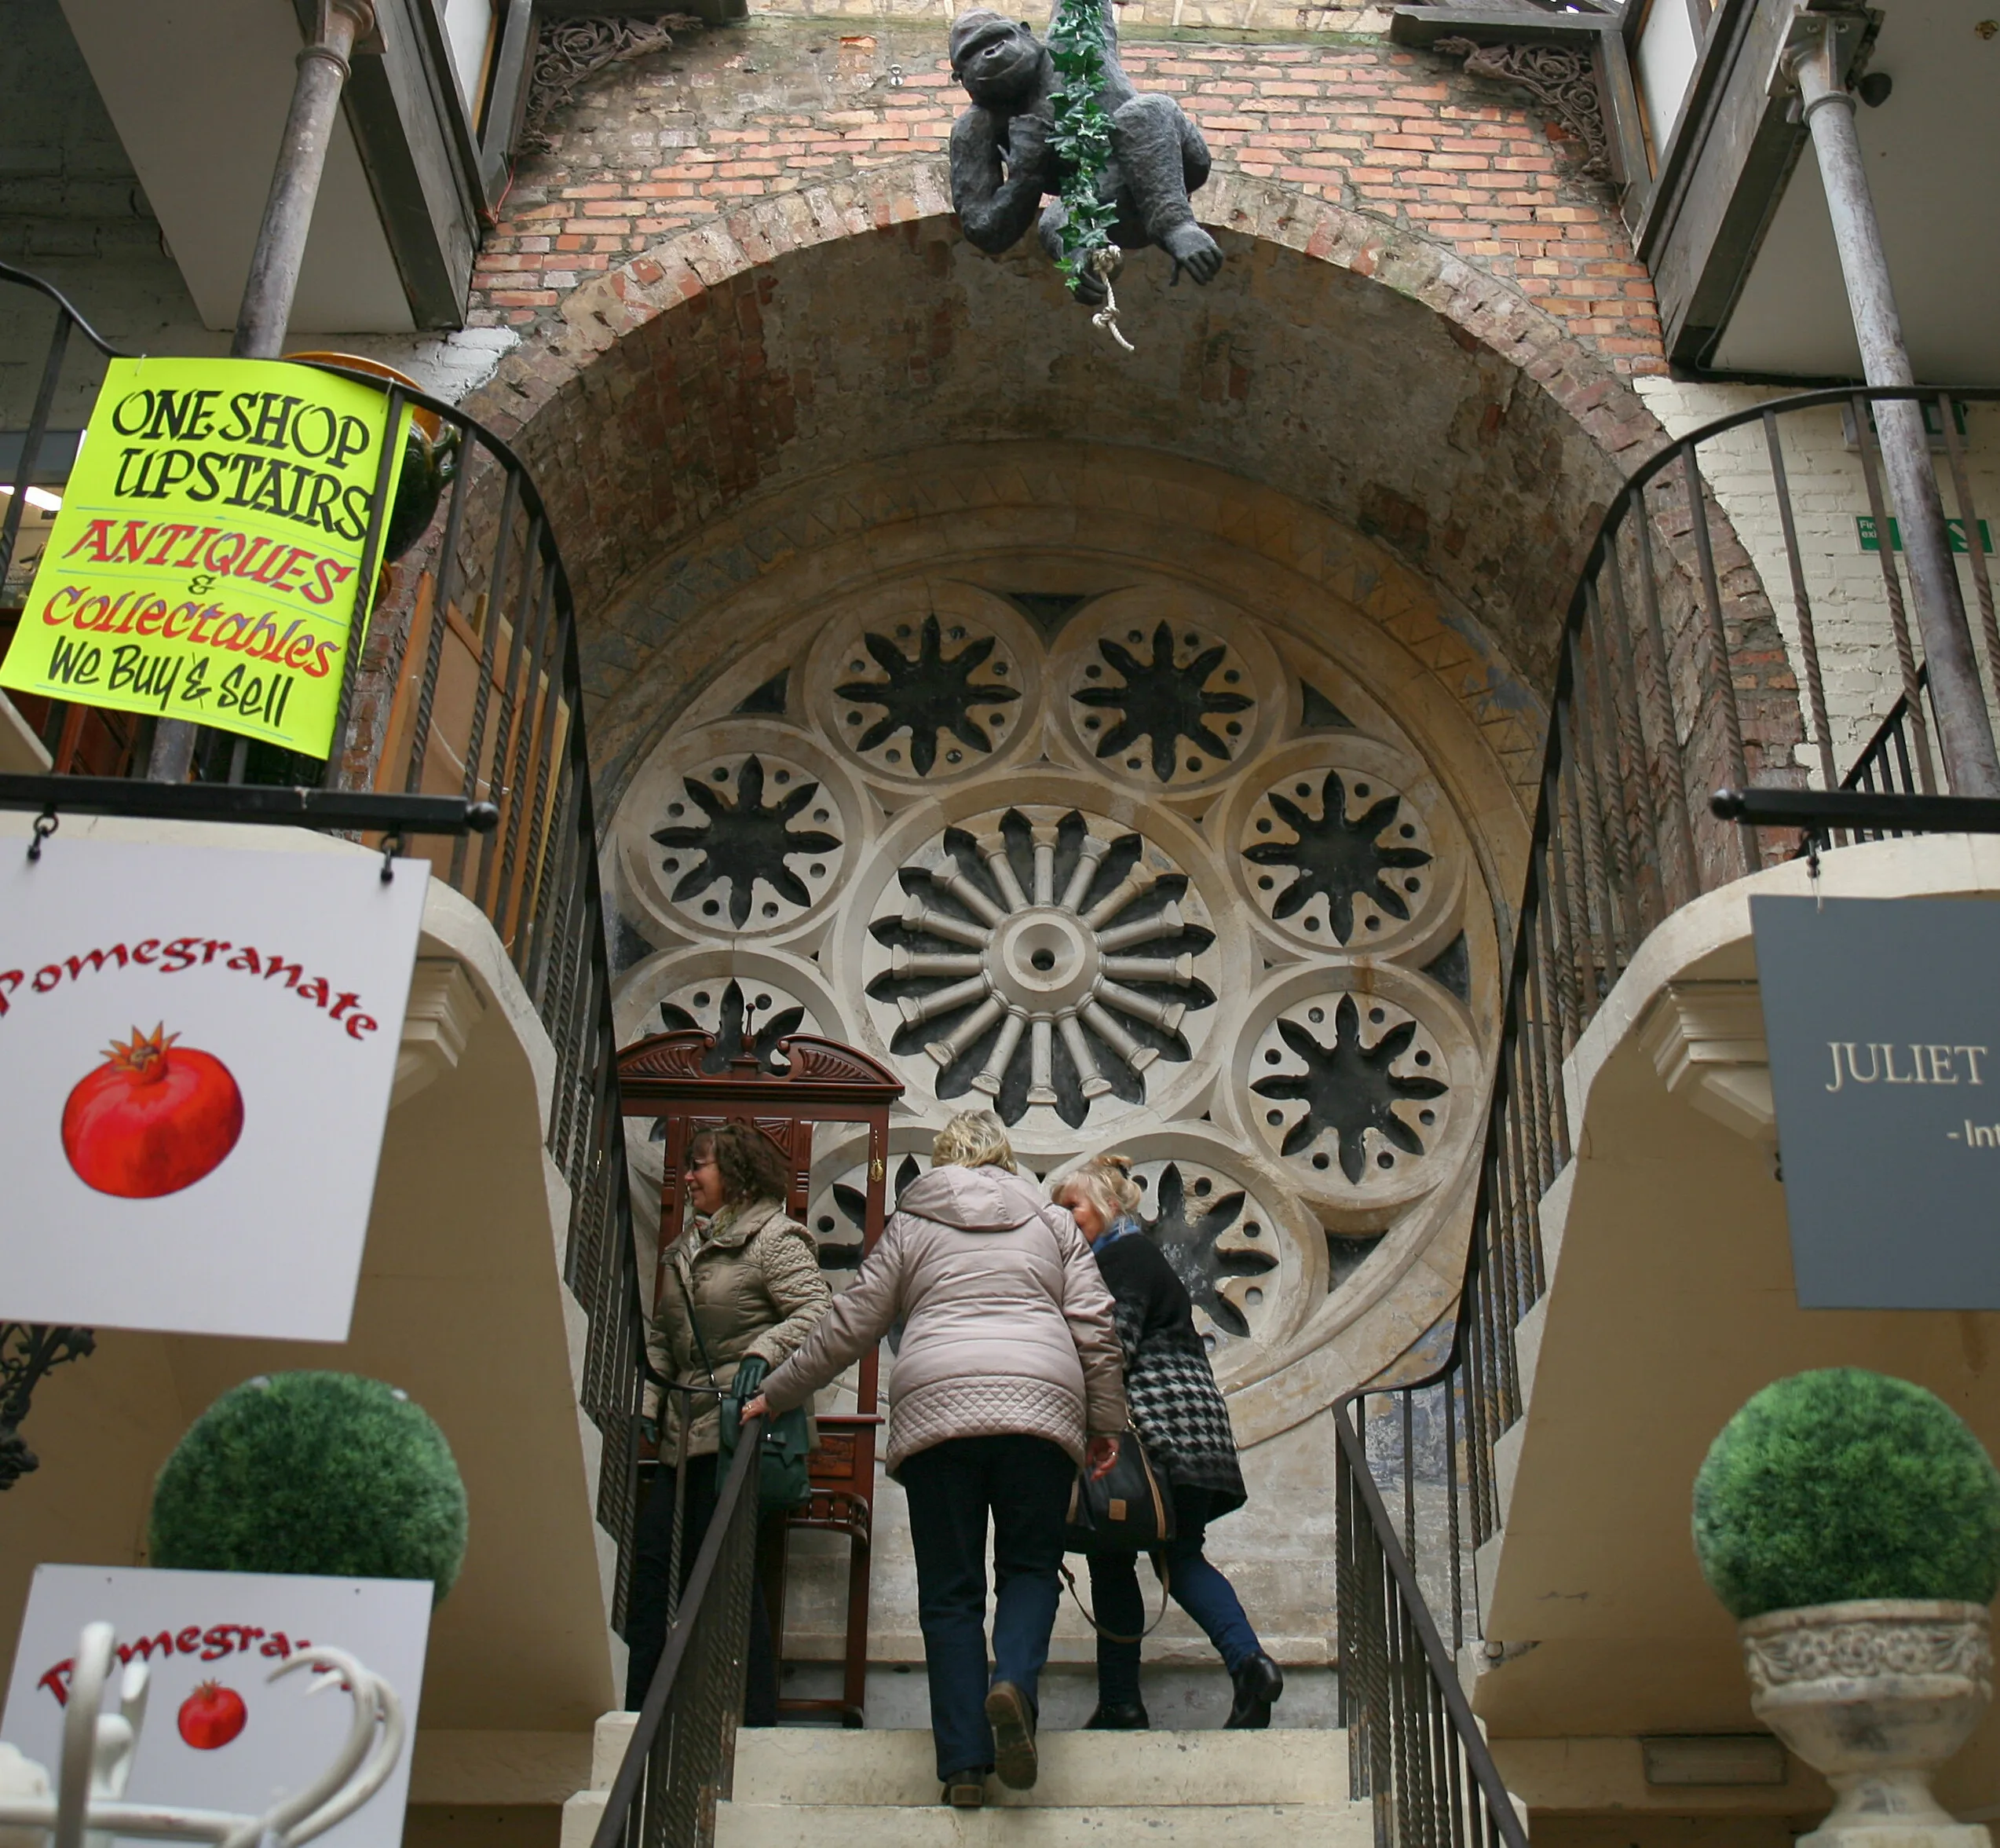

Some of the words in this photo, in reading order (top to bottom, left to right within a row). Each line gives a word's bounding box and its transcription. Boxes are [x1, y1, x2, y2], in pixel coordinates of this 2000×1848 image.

[112, 389, 224, 441] ONE
[218, 391, 370, 469] SHOP
[114, 448, 374, 542] UPSTAIRS
[1859, 520, 1876, 529] Fir
[62, 519, 356, 605] ANTIQUES
[188, 575, 216, 595] &
[42, 586, 341, 677] Collectables
[48, 635, 101, 684] We
[108, 645, 185, 711] Buy
[181, 653, 212, 709] &
[218, 664, 294, 727] Sell
[1825, 1041, 1988, 1092] JULIET
